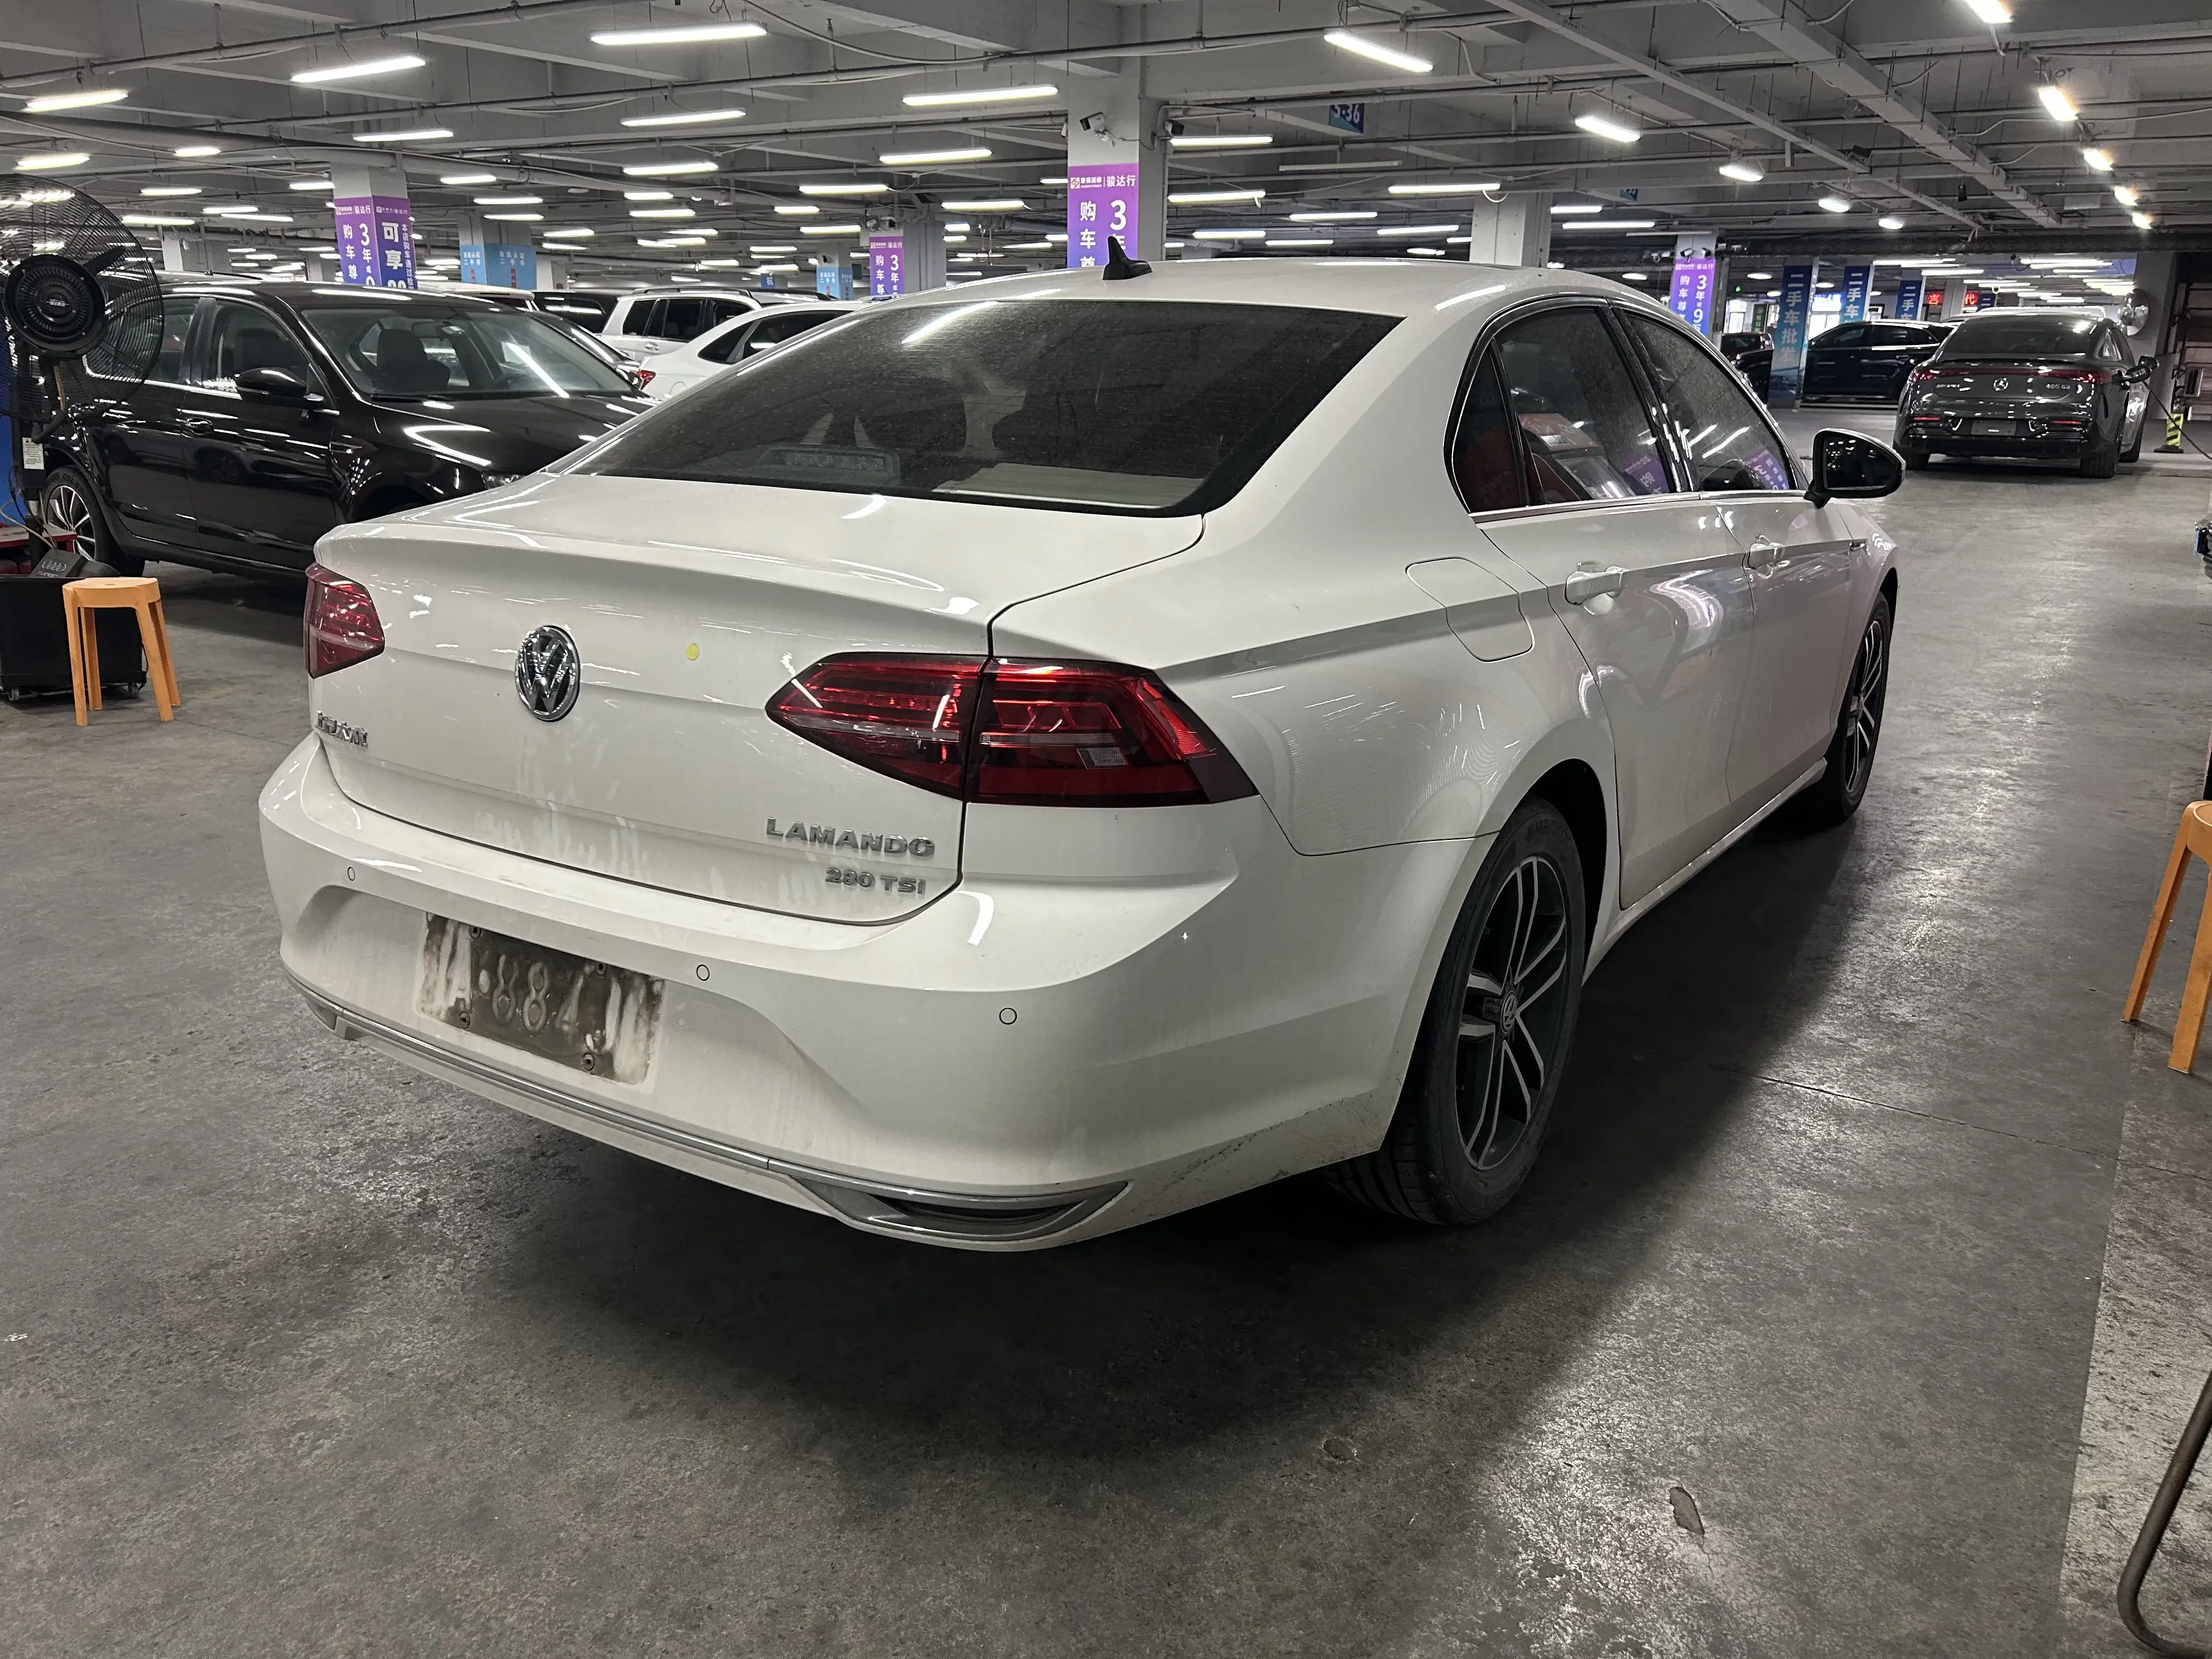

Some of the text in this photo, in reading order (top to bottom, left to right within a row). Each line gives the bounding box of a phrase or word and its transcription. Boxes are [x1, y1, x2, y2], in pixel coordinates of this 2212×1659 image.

[1106, 175, 1136, 188] 骏达行
[766, 816, 935, 857] LAMANDO
[825, 867, 927, 895] 280 TSI
